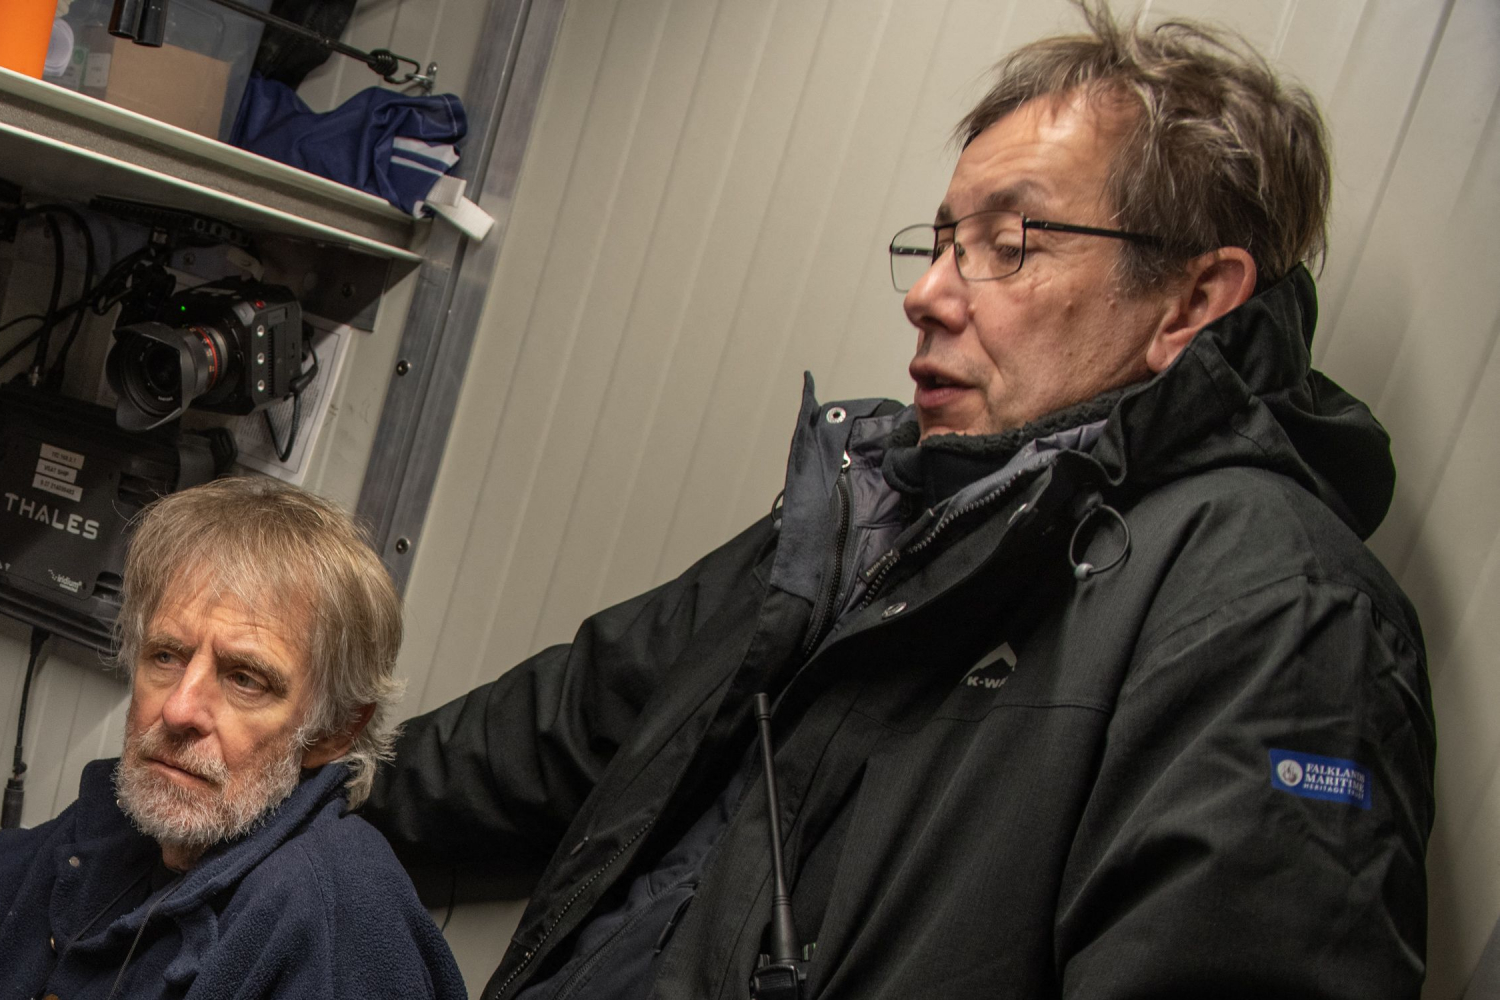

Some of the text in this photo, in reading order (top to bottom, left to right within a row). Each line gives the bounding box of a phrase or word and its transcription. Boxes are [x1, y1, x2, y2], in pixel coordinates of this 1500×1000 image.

[4, 492, 100, 540] THALES
[1306, 763, 1365, 782] FALKLANDS
[1303, 783, 1345, 794] HERITAGE
[1304, 773, 1365, 791] MARITIME
